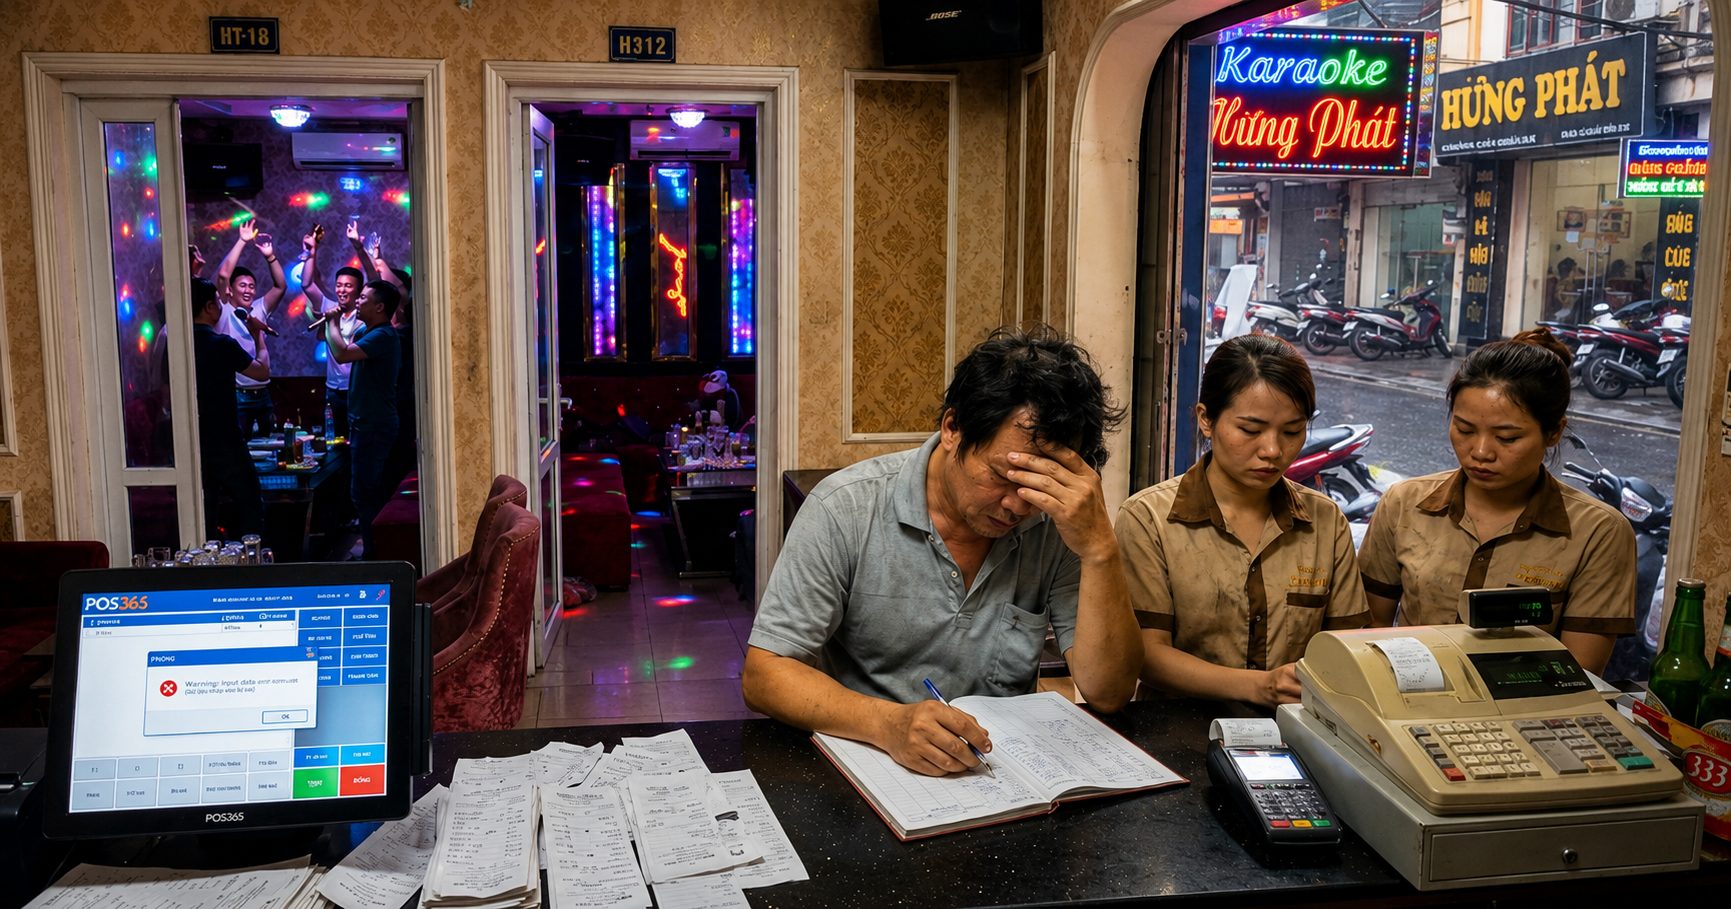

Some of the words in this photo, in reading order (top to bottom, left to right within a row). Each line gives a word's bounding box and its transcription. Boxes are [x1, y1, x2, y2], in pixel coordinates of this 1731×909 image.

[220, 26, 270, 46] HT-18
[619, 35, 666, 55] H312
[1215, 46, 1388, 86] Karaoke
[1534, 50, 1627, 119] PHÁT
[1309, 97, 1398, 159] Phát
[84, 595, 148, 611] POS365
[184, 680, 220, 688] Warning:
[1687, 755, 1728, 787] 333
[205, 811, 245, 823] POS365
